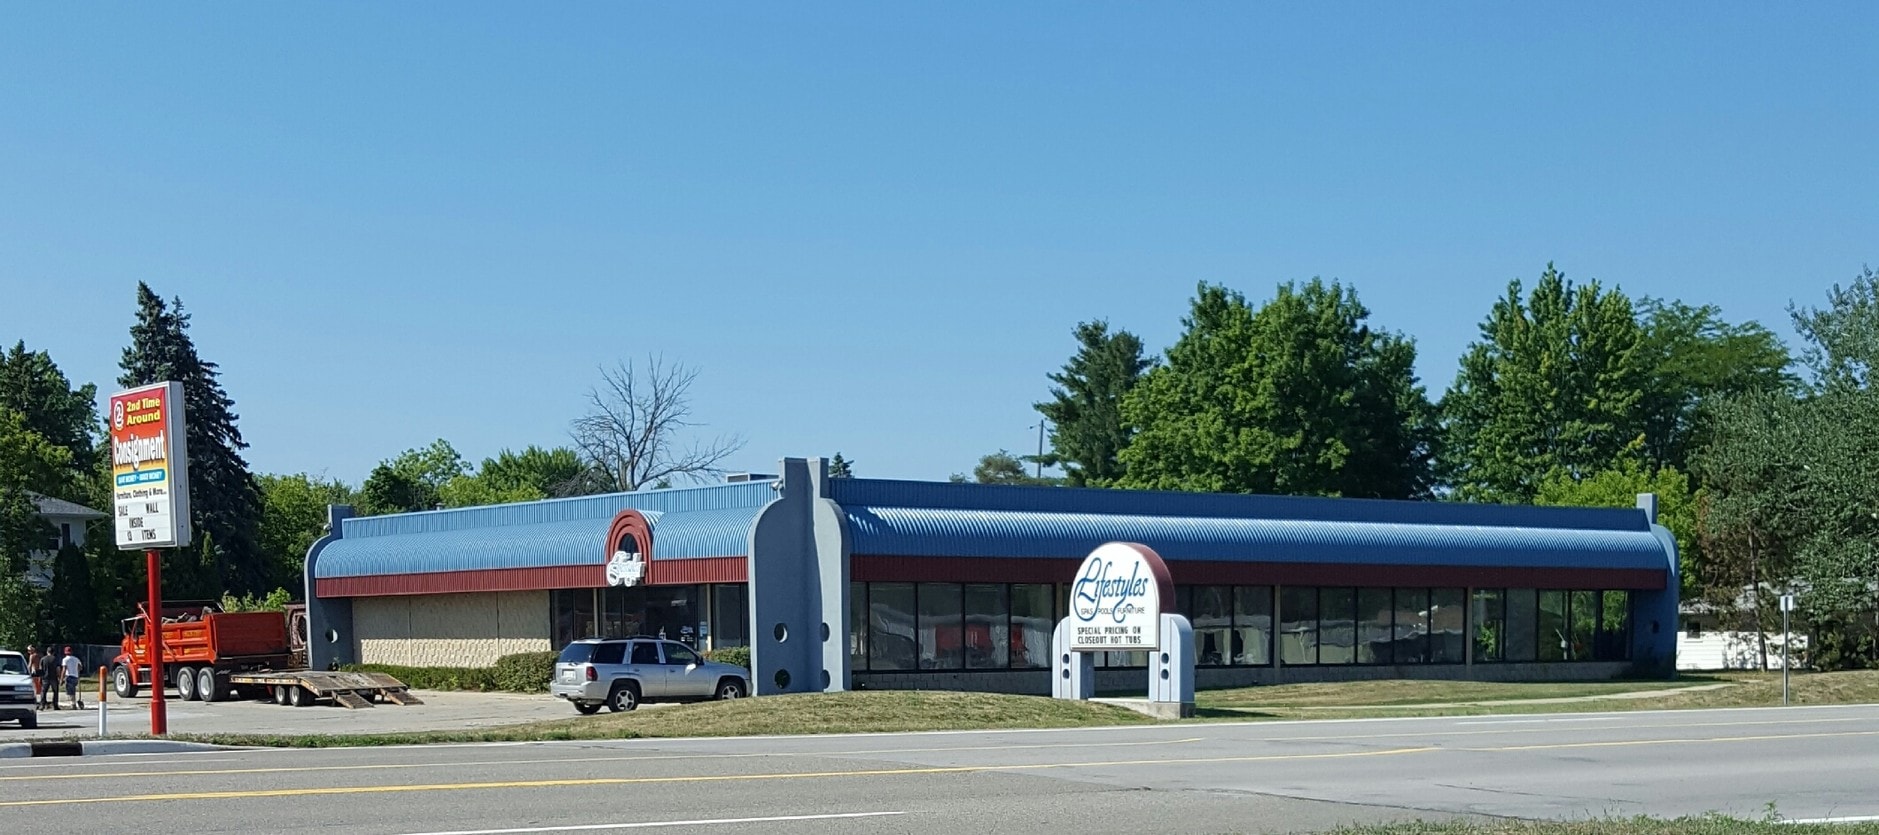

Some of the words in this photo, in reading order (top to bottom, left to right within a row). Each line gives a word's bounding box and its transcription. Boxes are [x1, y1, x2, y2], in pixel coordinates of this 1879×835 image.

[127, 400, 140, 412] 2nd
[142, 398, 160, 409] Time
[127, 410, 160, 425] Around
[114, 430, 165, 469] Consignment
[145, 502, 159, 514] WALL
[129, 517, 144, 528] INSIDE
[141, 529, 156, 541] ITEMS
[1073, 557, 1149, 623] Lifestyles
[1097, 607, 1113, 615] POOLS
[1117, 606, 1145, 615] FURNITURE
[1077, 627, 1101, 635] SPECIAL
[1104, 626, 1128, 634] PRICING
[1132, 626, 1141, 634] ON
[1077, 636, 1107, 644] CLOSEOUT
[1110, 636, 1122, 644] HOT
[1125, 636, 1141, 644] TUBS
